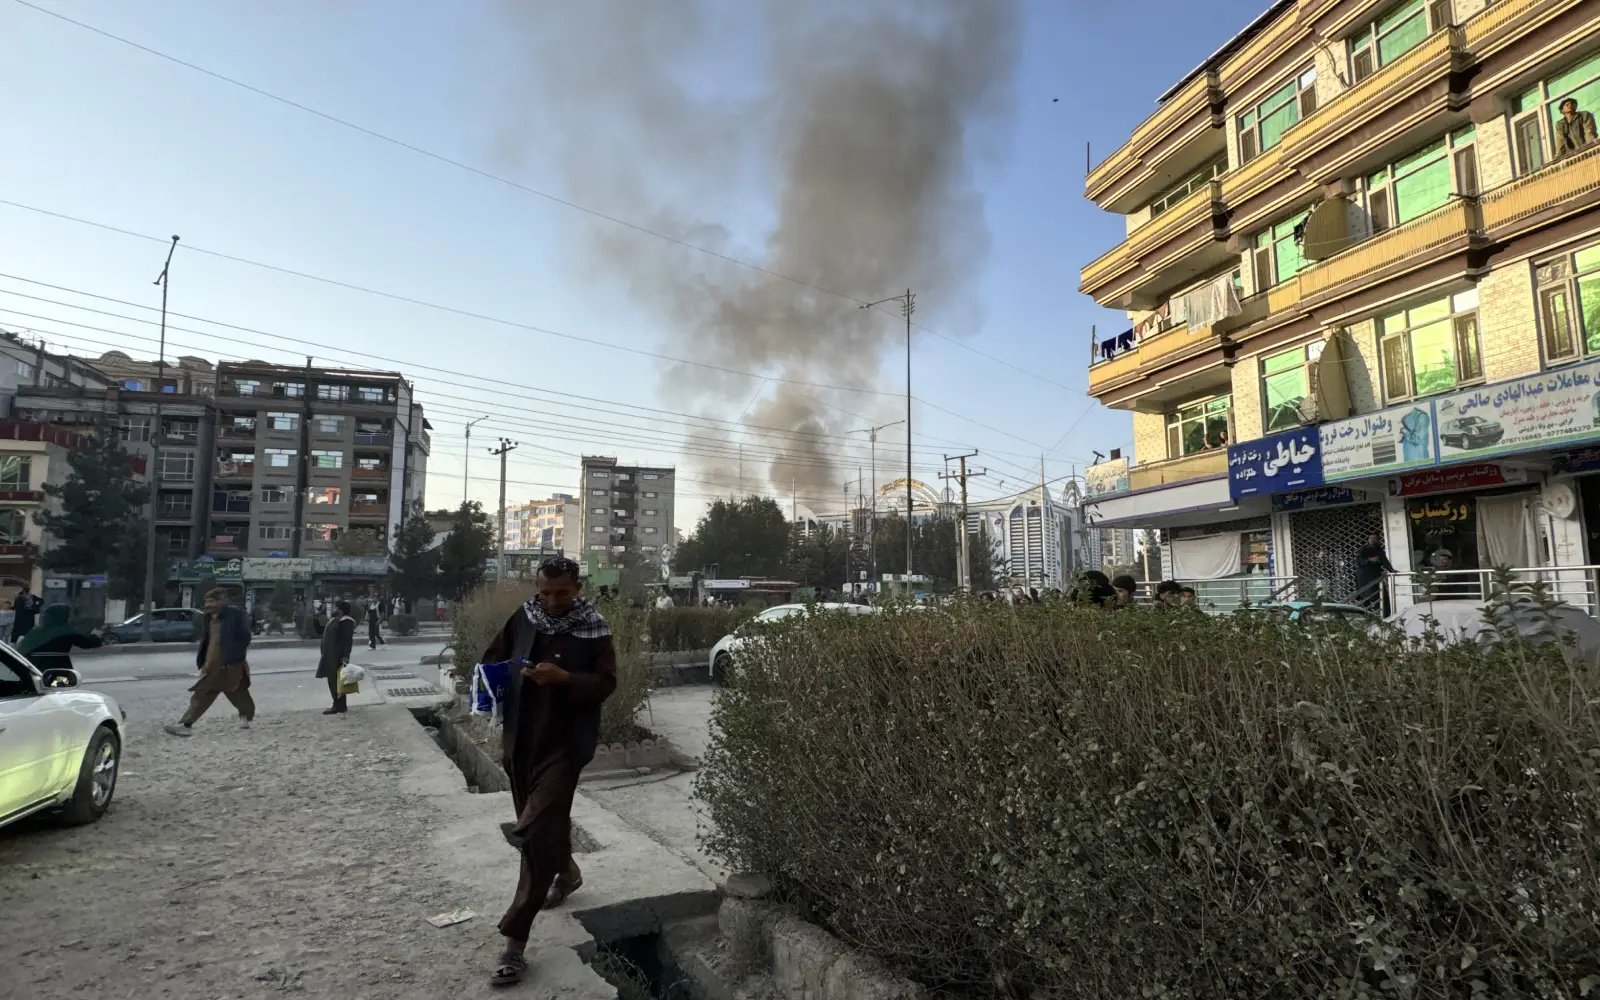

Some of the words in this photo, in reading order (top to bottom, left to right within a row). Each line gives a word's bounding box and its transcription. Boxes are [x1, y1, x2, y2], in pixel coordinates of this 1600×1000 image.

[1547, 370, 1590, 392] معاملات
[1459, 393, 1490, 415] صالحی
[1339, 422, 1360, 440] رخت
[1248, 450, 1262, 460] رخت
[1264, 436, 1316, 477] خیاطی
[1410, 501, 1468, 524] ورکشاپ
